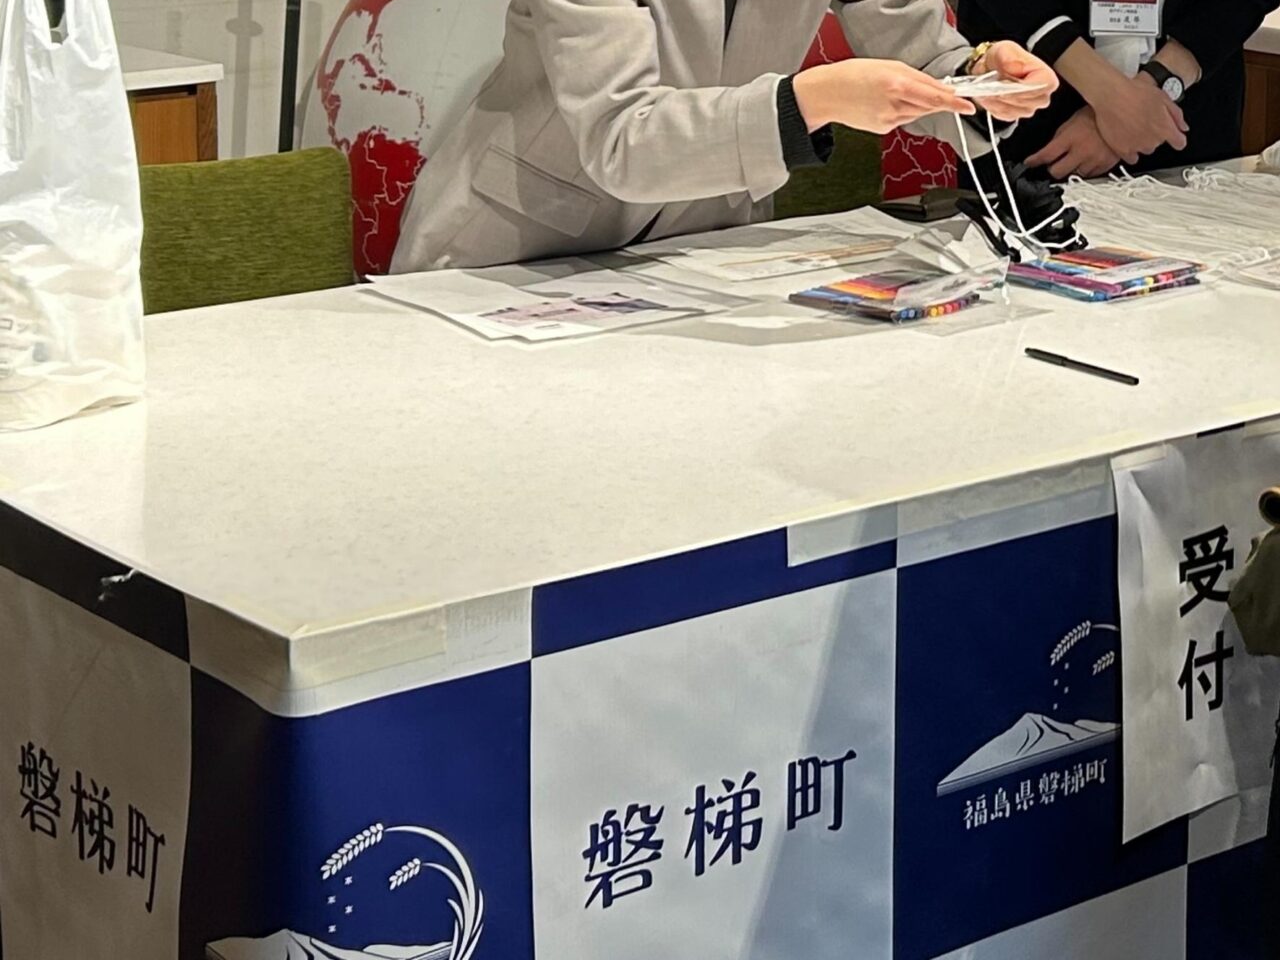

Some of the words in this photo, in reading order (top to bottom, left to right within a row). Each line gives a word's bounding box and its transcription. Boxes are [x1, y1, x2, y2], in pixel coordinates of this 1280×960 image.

[1178, 524, 1234, 721] 受付
[18, 741, 165, 913] 磐梯町
[582, 749, 857, 909] 磐梯町
[963, 758, 1108, 830] 福島県磐梯町
